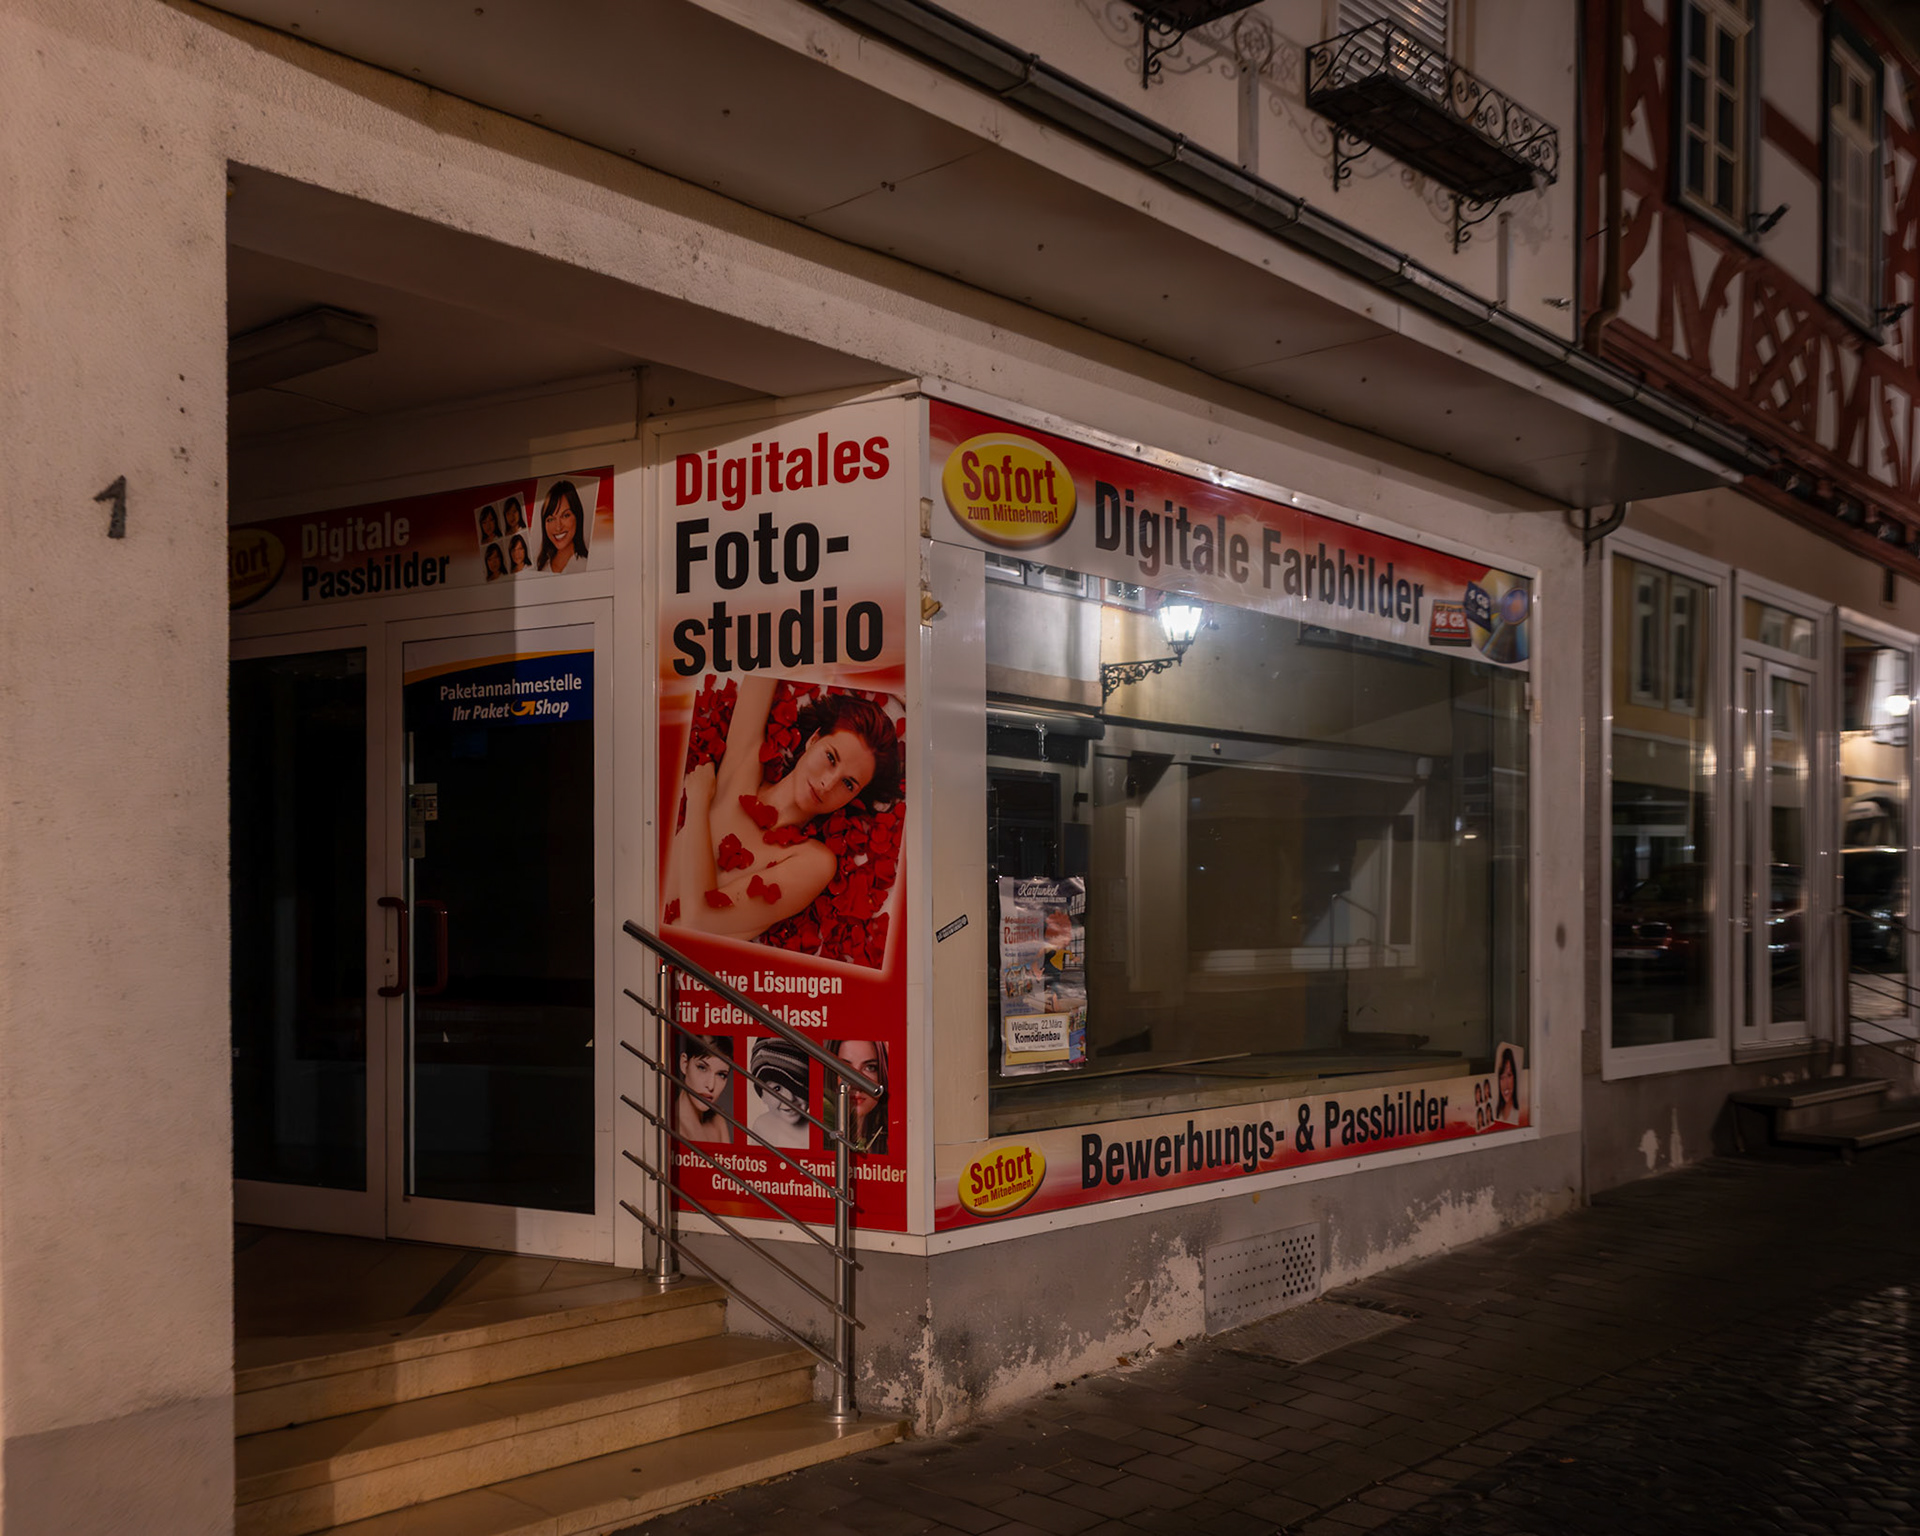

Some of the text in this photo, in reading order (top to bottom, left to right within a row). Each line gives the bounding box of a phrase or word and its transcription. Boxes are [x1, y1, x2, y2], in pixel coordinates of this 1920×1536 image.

[676, 432, 890, 511] Digitales
[961, 450, 1058, 505] Sofort
[93, 475, 127, 539] 1
[967, 503, 1058, 524] zum Mitnehmen!
[302, 512, 410, 562] Digitale
[676, 512, 849, 594] Foto-
[1095, 480, 1424, 625] Digitale Farbbilder
[302, 552, 450, 600] Passbilder
[673, 586, 883, 677] studio
[440, 673, 582, 700] Paketannahmestelle
[452, 699, 570, 721] Ihr Paket Shop
[753, 971, 843, 998] Lösungen
[675, 1002, 699, 1023] für
[1011, 1021, 1039, 1032] Weilburg
[1014, 1031, 1060, 1044] Komödienbau
[1082, 1089, 1448, 1189] Bewerbungs- & Passbilder
[970, 1147, 1033, 1194] Sofort
[974, 1176, 1034, 1207] zum Mitnehmen!
